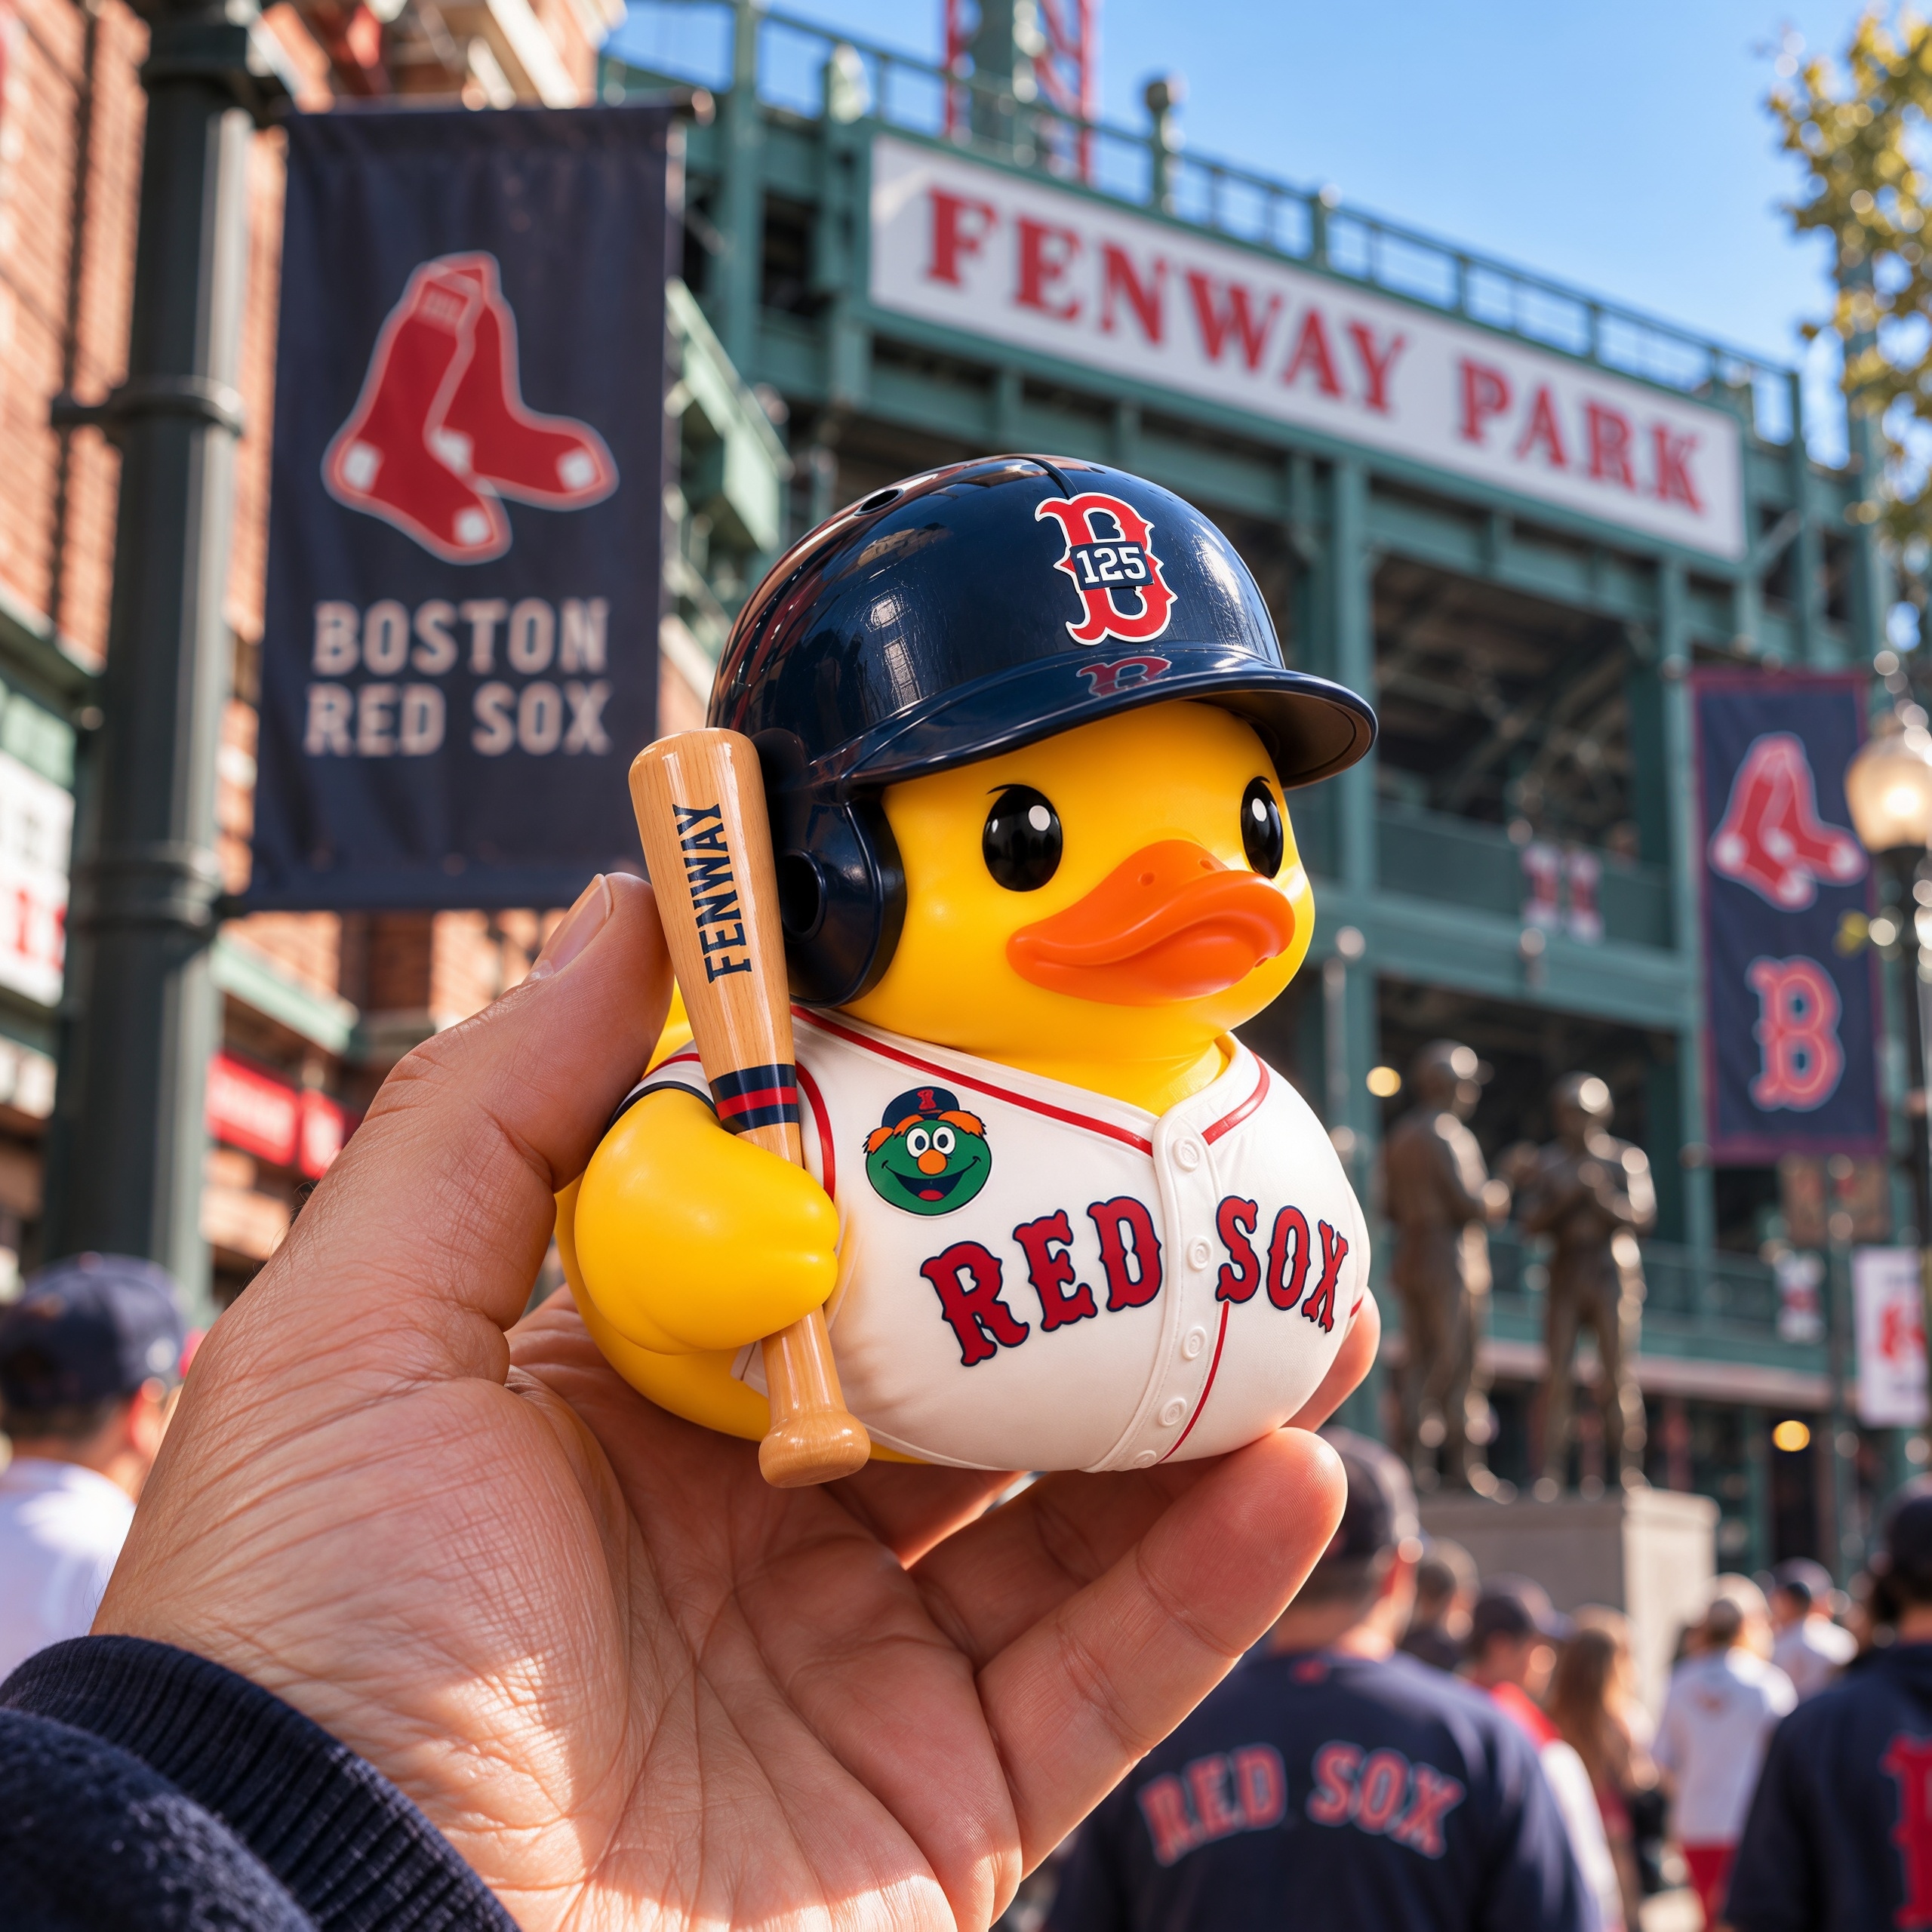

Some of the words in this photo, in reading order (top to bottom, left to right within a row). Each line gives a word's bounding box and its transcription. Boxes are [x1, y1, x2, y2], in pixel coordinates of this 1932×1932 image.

[925, 184, 1407, 414] FENWAY
[1457, 358, 1706, 513] PARK
[312, 598, 609, 675] BOSTON
[1035, 492, 1179, 646] B
[1076, 546, 1147, 584] 125
[304, 682, 447, 755] RED
[472, 680, 613, 755] SOX
[672, 803, 752, 984] FENWAY
[1746, 955, 1844, 1112] B
[920, 1195, 1163, 1367] RED
[1215, 1195, 1349, 1334] SOX
[1139, 1743, 1287, 1867] RED
[1306, 1740, 1465, 1860] SOX
